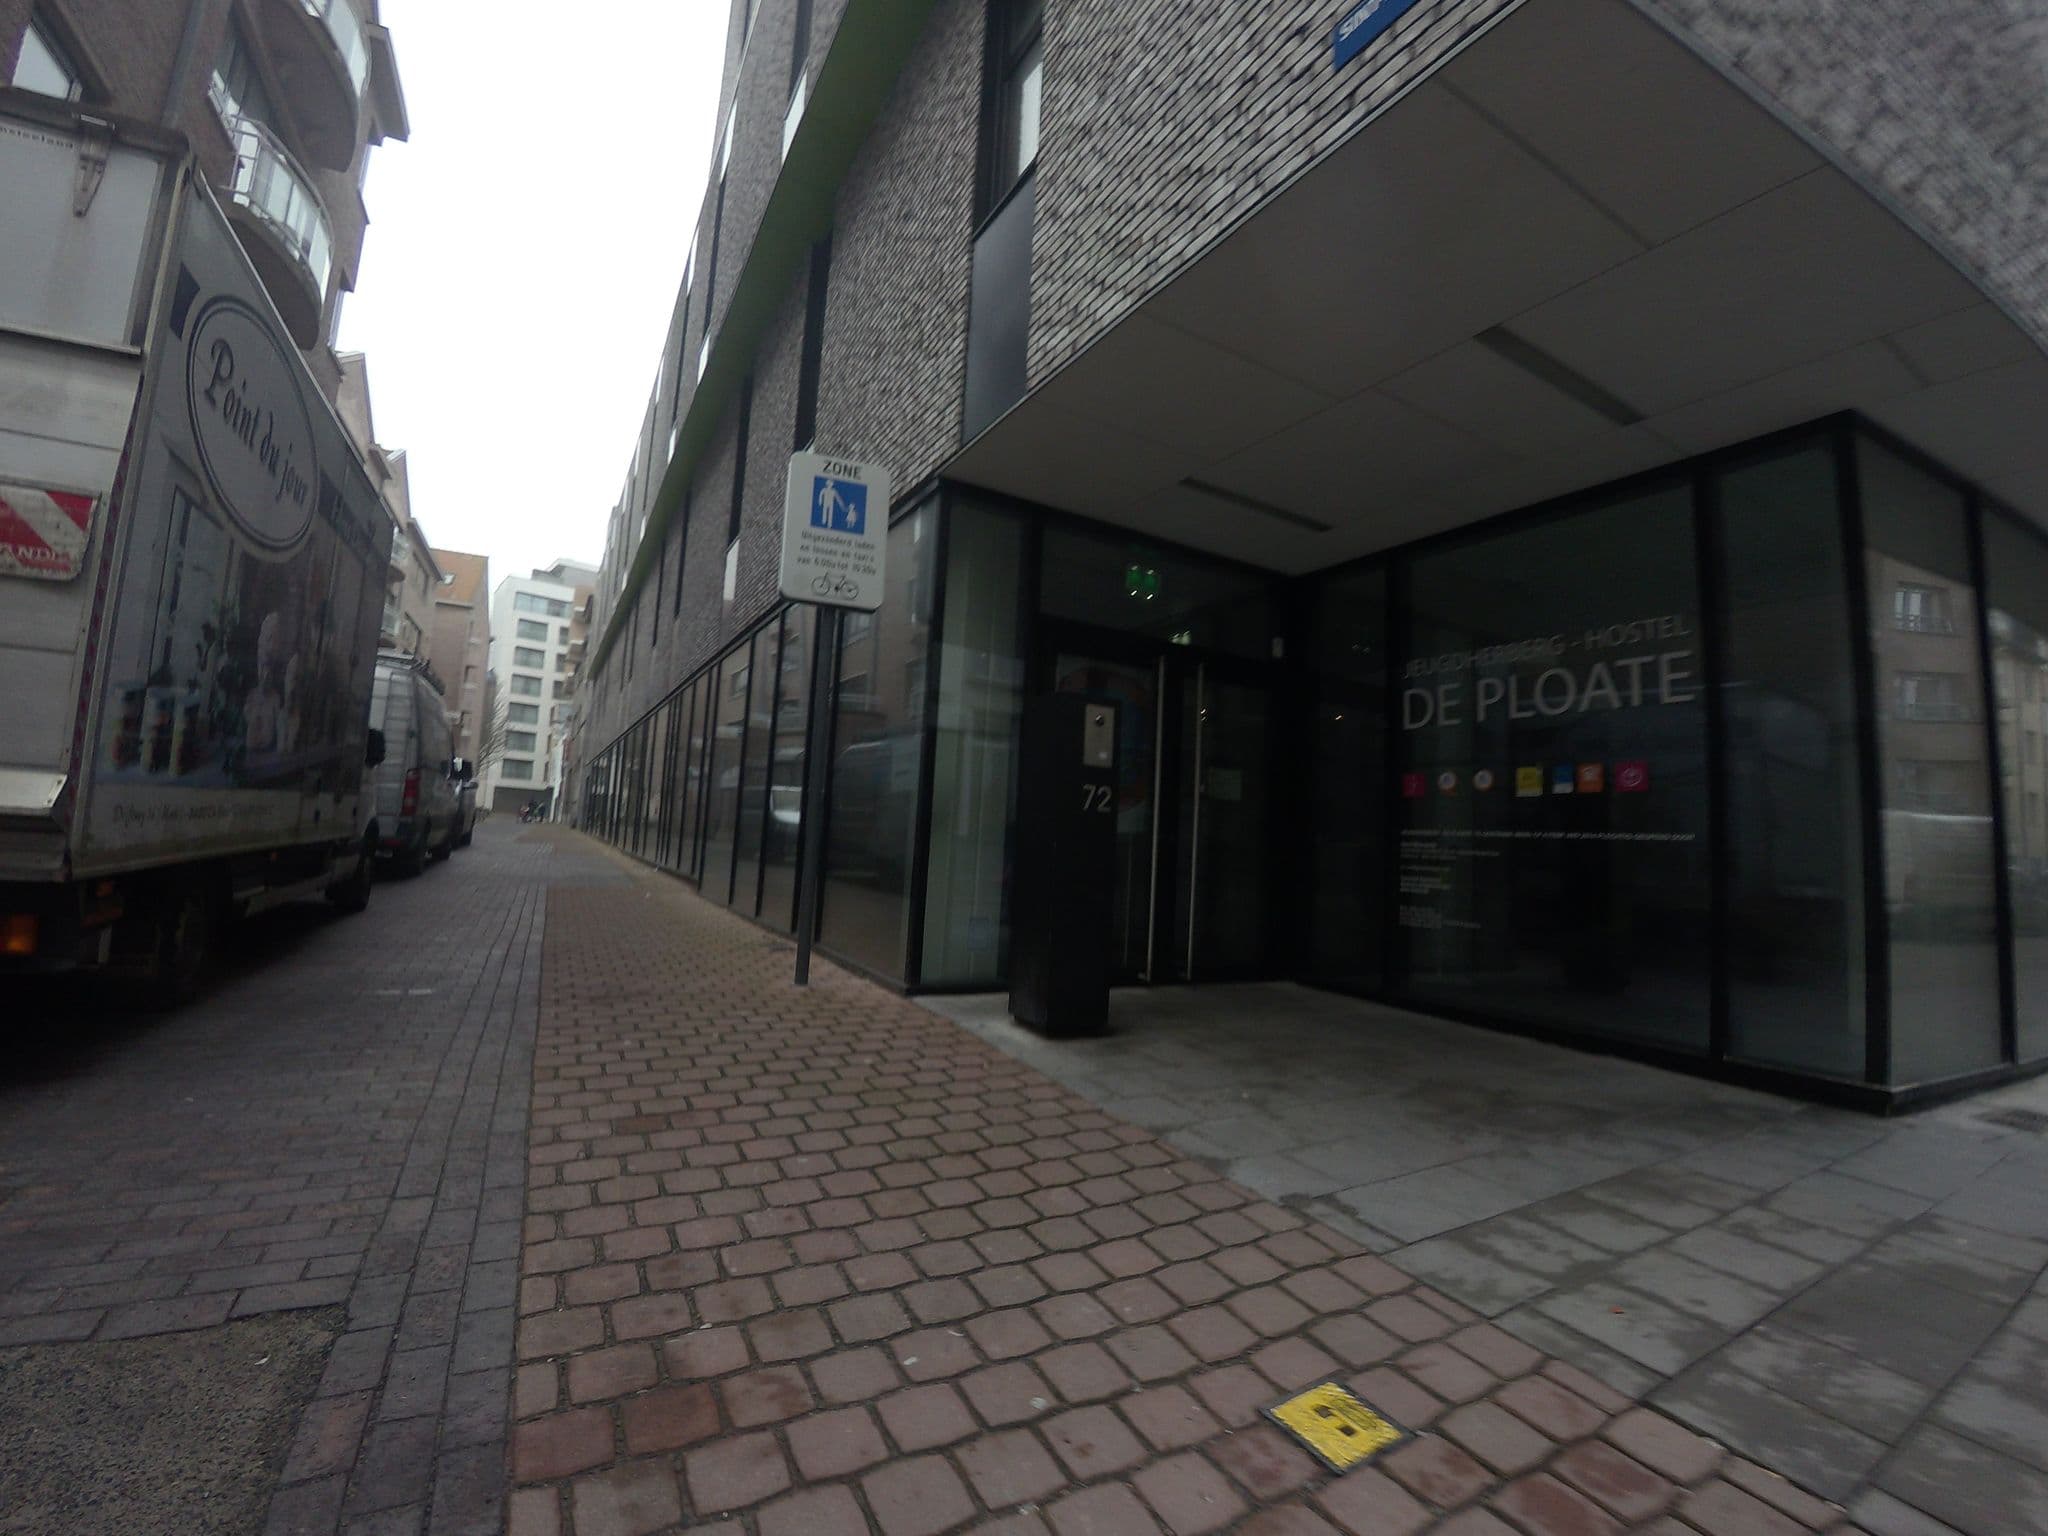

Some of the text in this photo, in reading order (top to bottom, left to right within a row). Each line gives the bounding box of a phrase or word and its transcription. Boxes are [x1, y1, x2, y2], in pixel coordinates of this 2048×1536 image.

[203, 338, 259, 452] Point
[259, 410, 279, 478] du
[823, 460, 863, 479] ZONE
[1583, 616, 1694, 650] HOSTEL
[1402, 650, 1697, 730] DE PLOATE
[1082, 784, 1112, 813] 72
